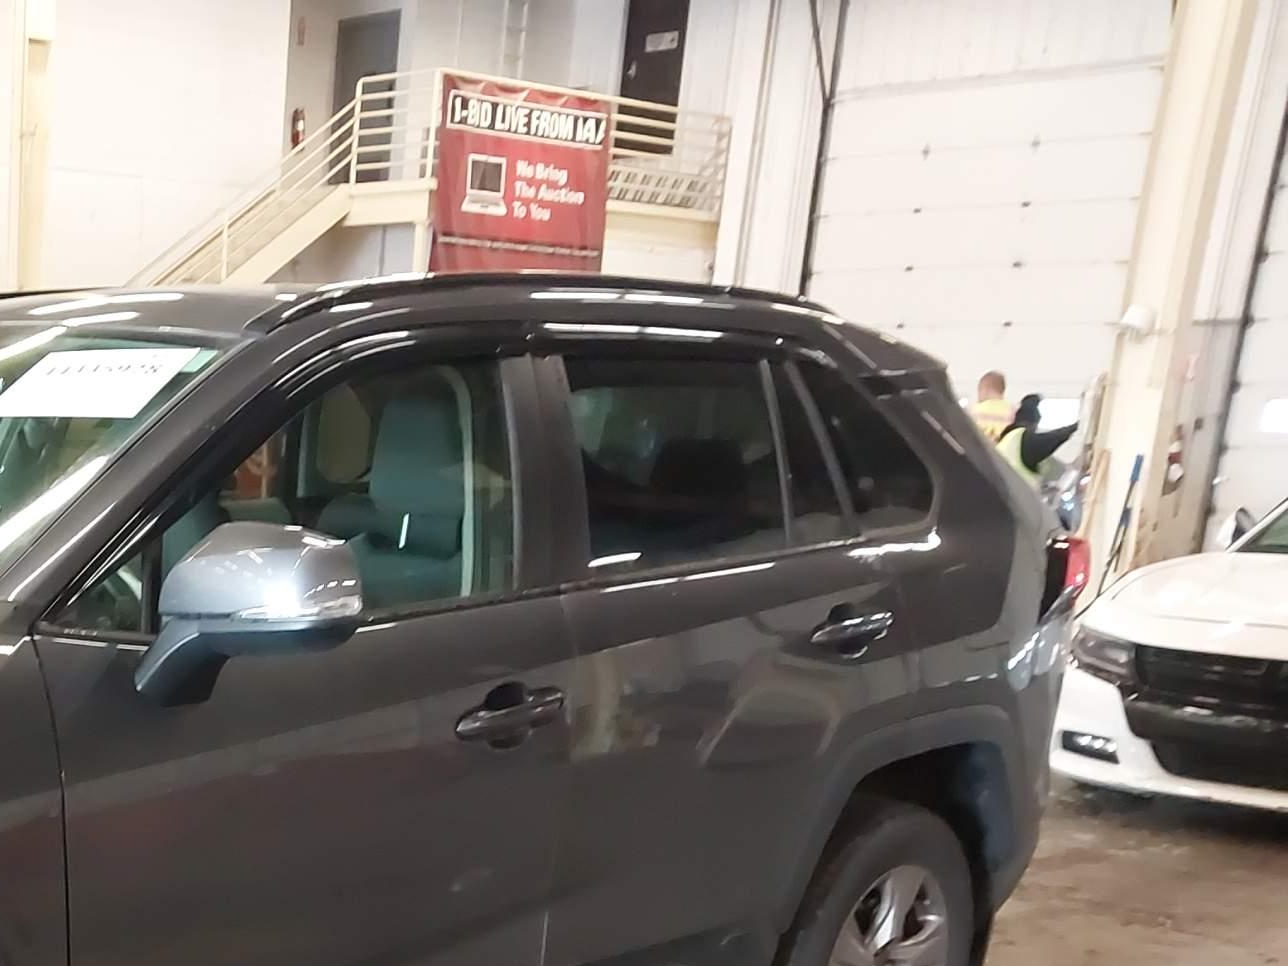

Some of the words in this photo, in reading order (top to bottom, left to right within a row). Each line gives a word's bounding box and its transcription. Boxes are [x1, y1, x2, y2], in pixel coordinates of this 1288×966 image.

[494, 103, 529, 135] LIVE
[529, 110, 574, 141] FROM
[516, 160, 534, 179] We
[535, 162, 568, 187] Bring
[514, 180, 536, 199] The
[537, 183, 585, 206] Auction
[512, 200, 527, 219] To
[529, 202, 552, 222] You
